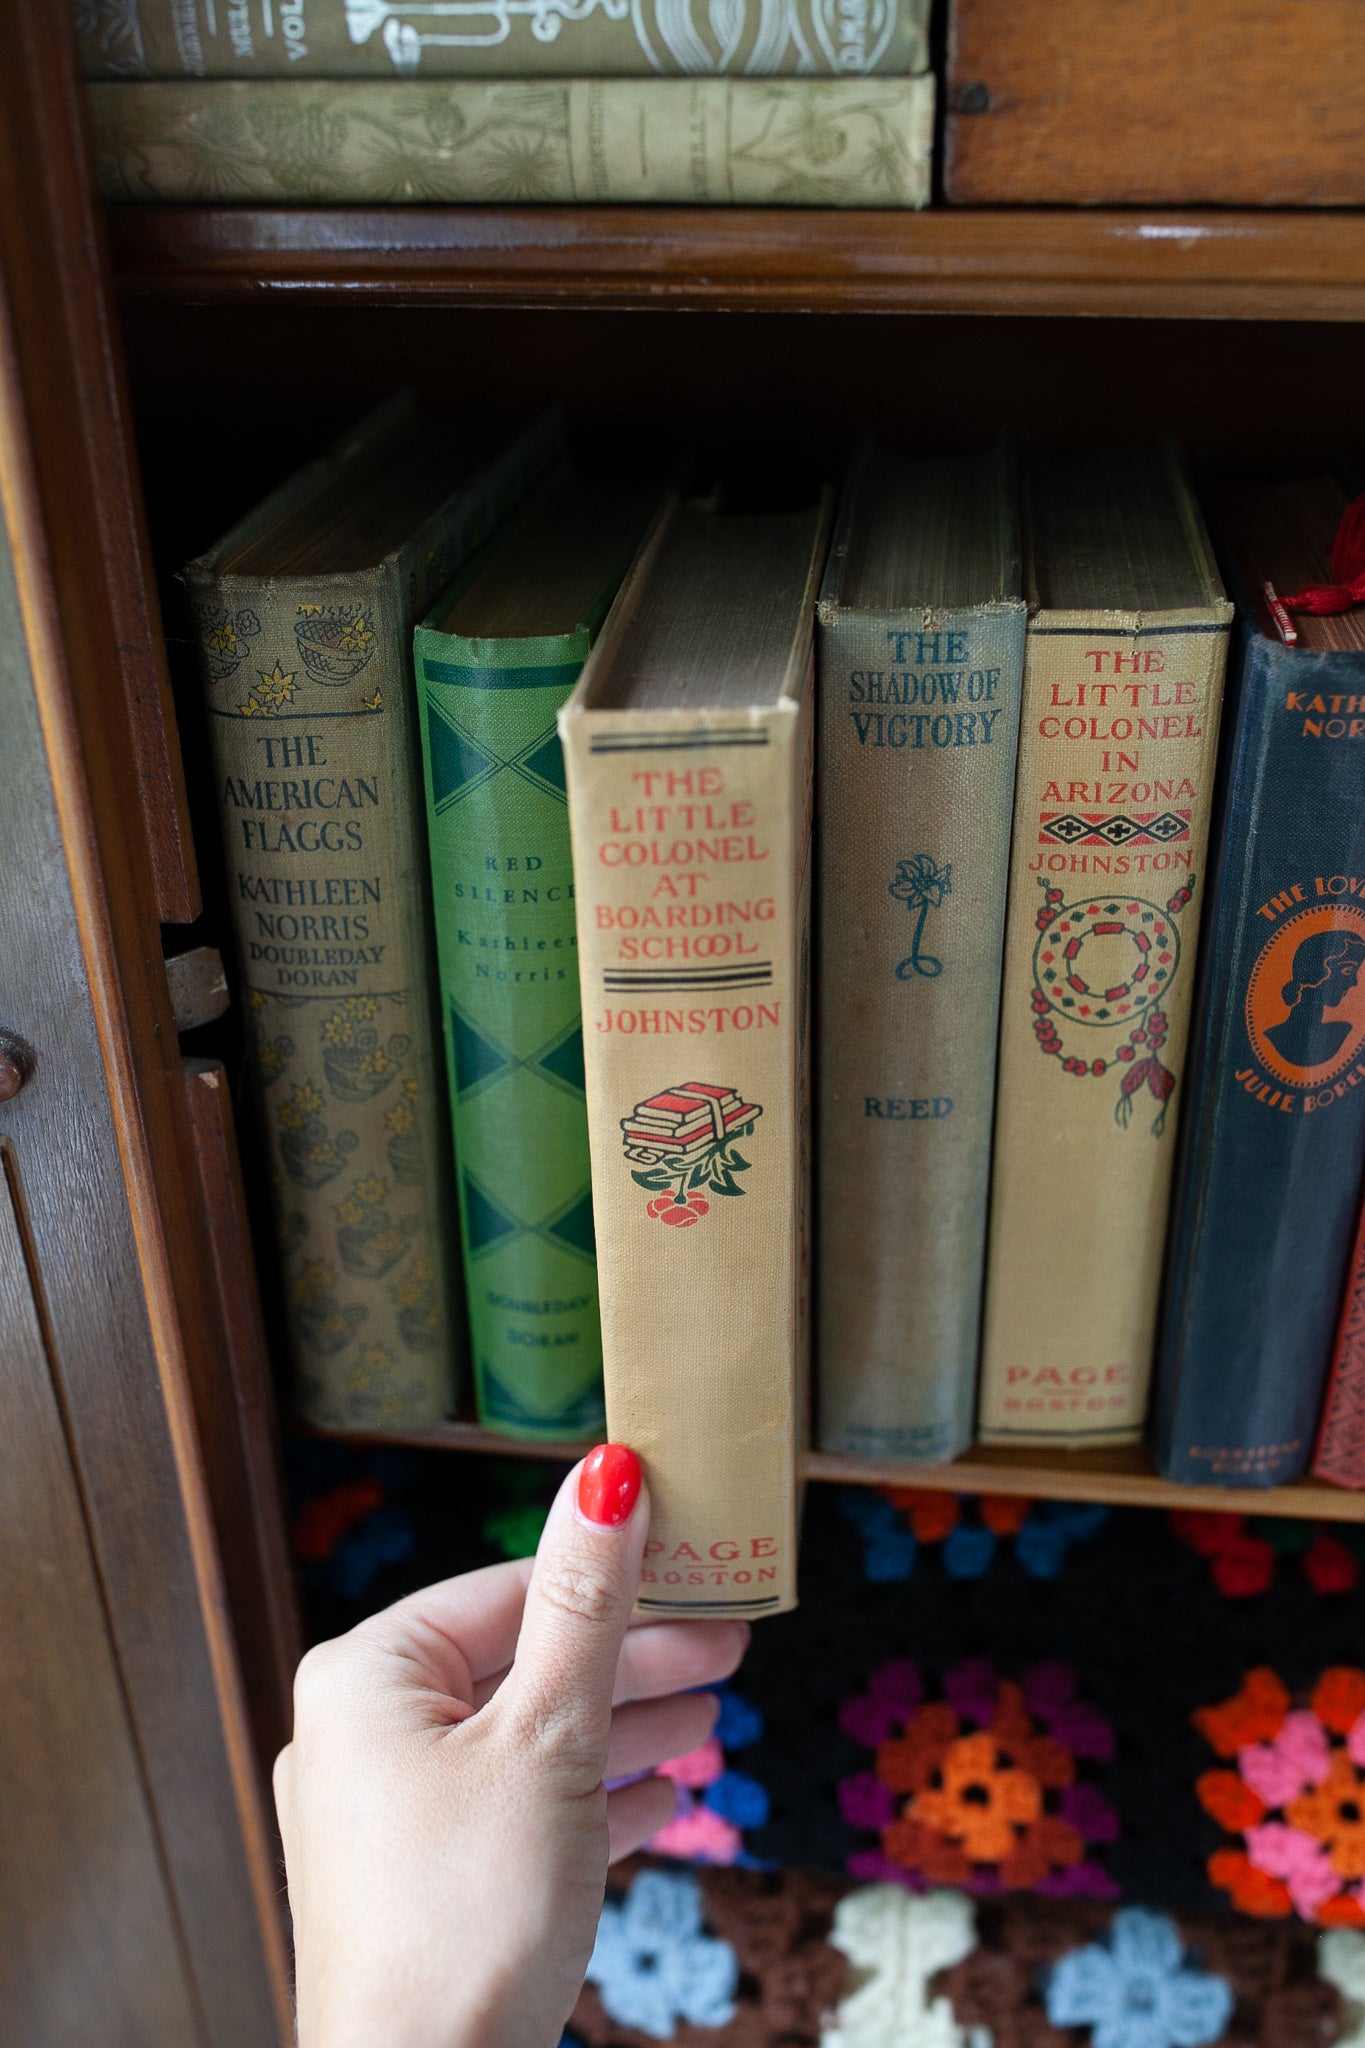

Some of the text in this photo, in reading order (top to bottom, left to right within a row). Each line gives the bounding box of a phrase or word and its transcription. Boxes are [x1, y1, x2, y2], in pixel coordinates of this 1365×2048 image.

[887, 630, 970, 665] THE
[1085, 651, 1165, 674] THE
[849, 667, 1001, 706] SHADOW OF
[1050, 682, 1198, 708] LITTLE
[1038, 716, 1201, 741] COLONEL
[256, 735, 328, 769] THE
[1101, 750, 1140, 773] IN
[223, 776, 381, 812] AMERICAN
[633, 767, 726, 799] THE
[1042, 779, 1196, 805] ARIZONA
[608, 800, 756, 834] LITTLE
[241, 821, 363, 854] FLAGGS
[598, 835, 771, 869] COLONEL
[485, 856, 544, 872] RED
[1028, 850, 1195, 875] JOHNSTON
[237, 873, 382, 908] KATHLEEN
[651, 872, 709, 901] AT
[595, 898, 778, 931] BOARDING
[1257, 884, 1309, 922] THE
[254, 911, 371, 943] NORRIS
[249, 942, 388, 966] DOUBLEDAY
[617, 931, 762, 961] SCHOOL
[277, 968, 359, 988] DORAN
[475, 964, 566, 983] Norris
[596, 1001, 782, 1036] JOHNSTON
[1235, 1068, 1294, 1113] JULIE
[863, 1096, 954, 1120] REED
[1006, 1364, 1131, 1388] PAGE
[643, 1537, 779, 1562] PAGE
[640, 1566, 778, 1586] BOSTON
